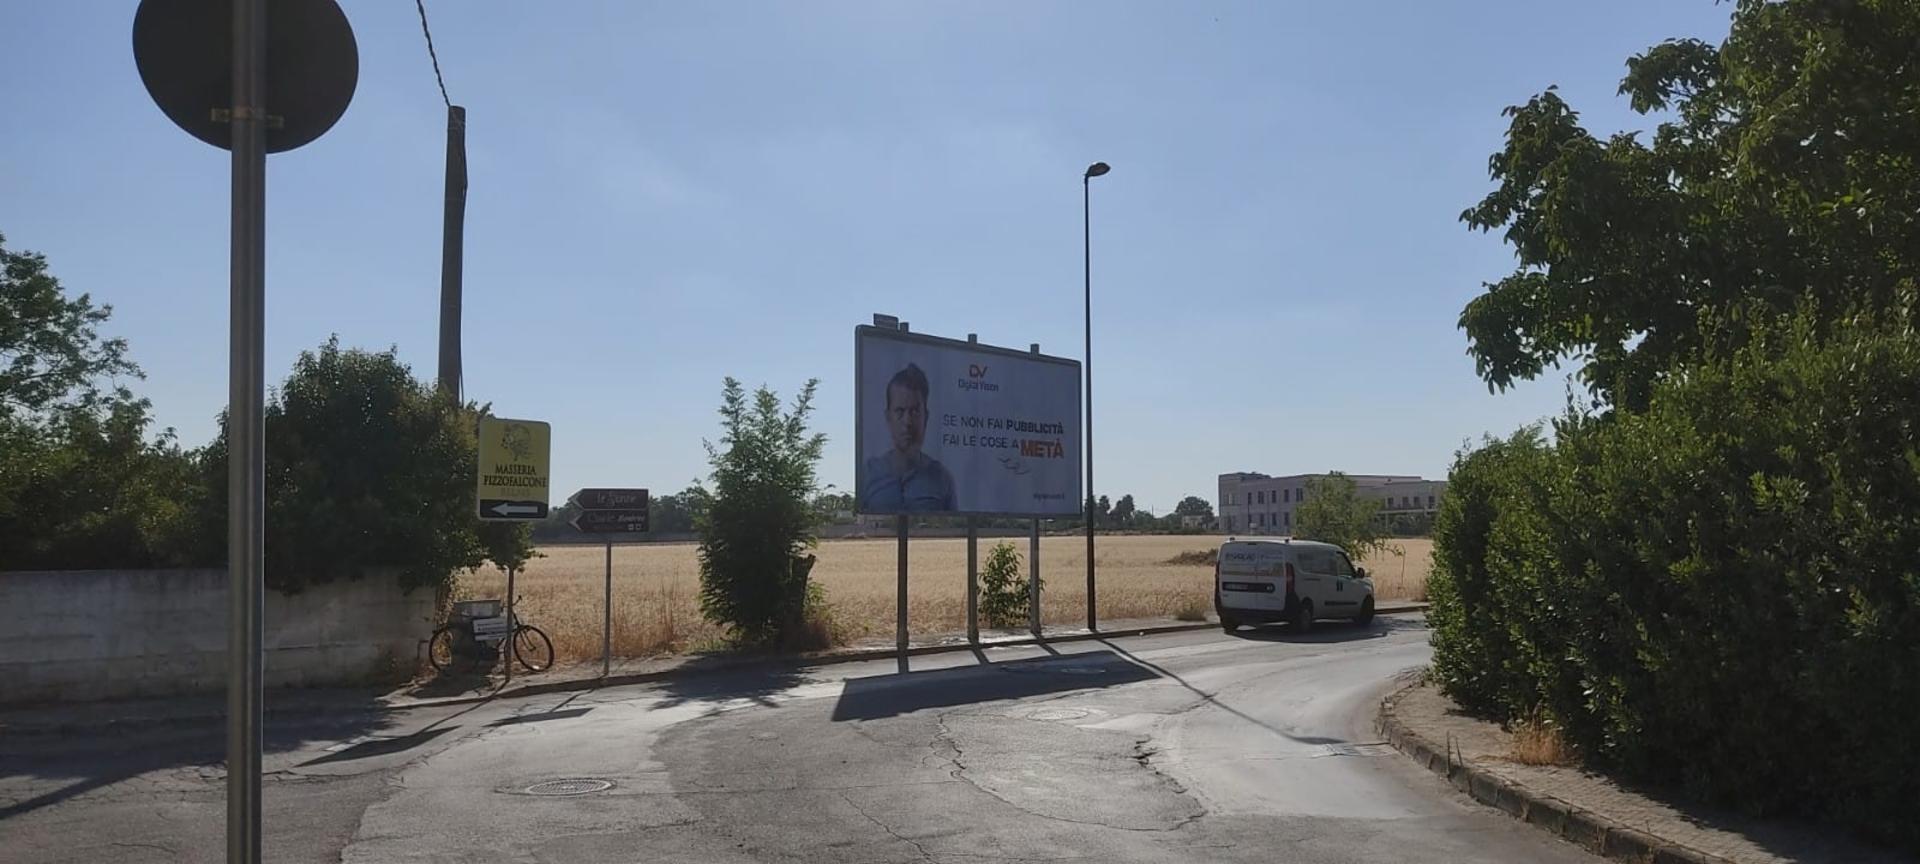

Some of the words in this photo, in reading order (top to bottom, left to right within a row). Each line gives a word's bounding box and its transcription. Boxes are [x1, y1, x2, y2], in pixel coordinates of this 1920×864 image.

[943, 414, 957, 427] SE
[961, 416, 984, 429] NON
[987, 418, 1003, 430] FAI
[1006, 419, 1064, 434] PUBBLICITÀ
[942, 433, 960, 446] FAI
[962, 434, 976, 447] LE
[980, 436, 1009, 448] COSE
[1011, 439, 1020, 449] A
[1020, 438, 1064, 459] METÀ
[495, 463, 537, 475] MASSERIA
